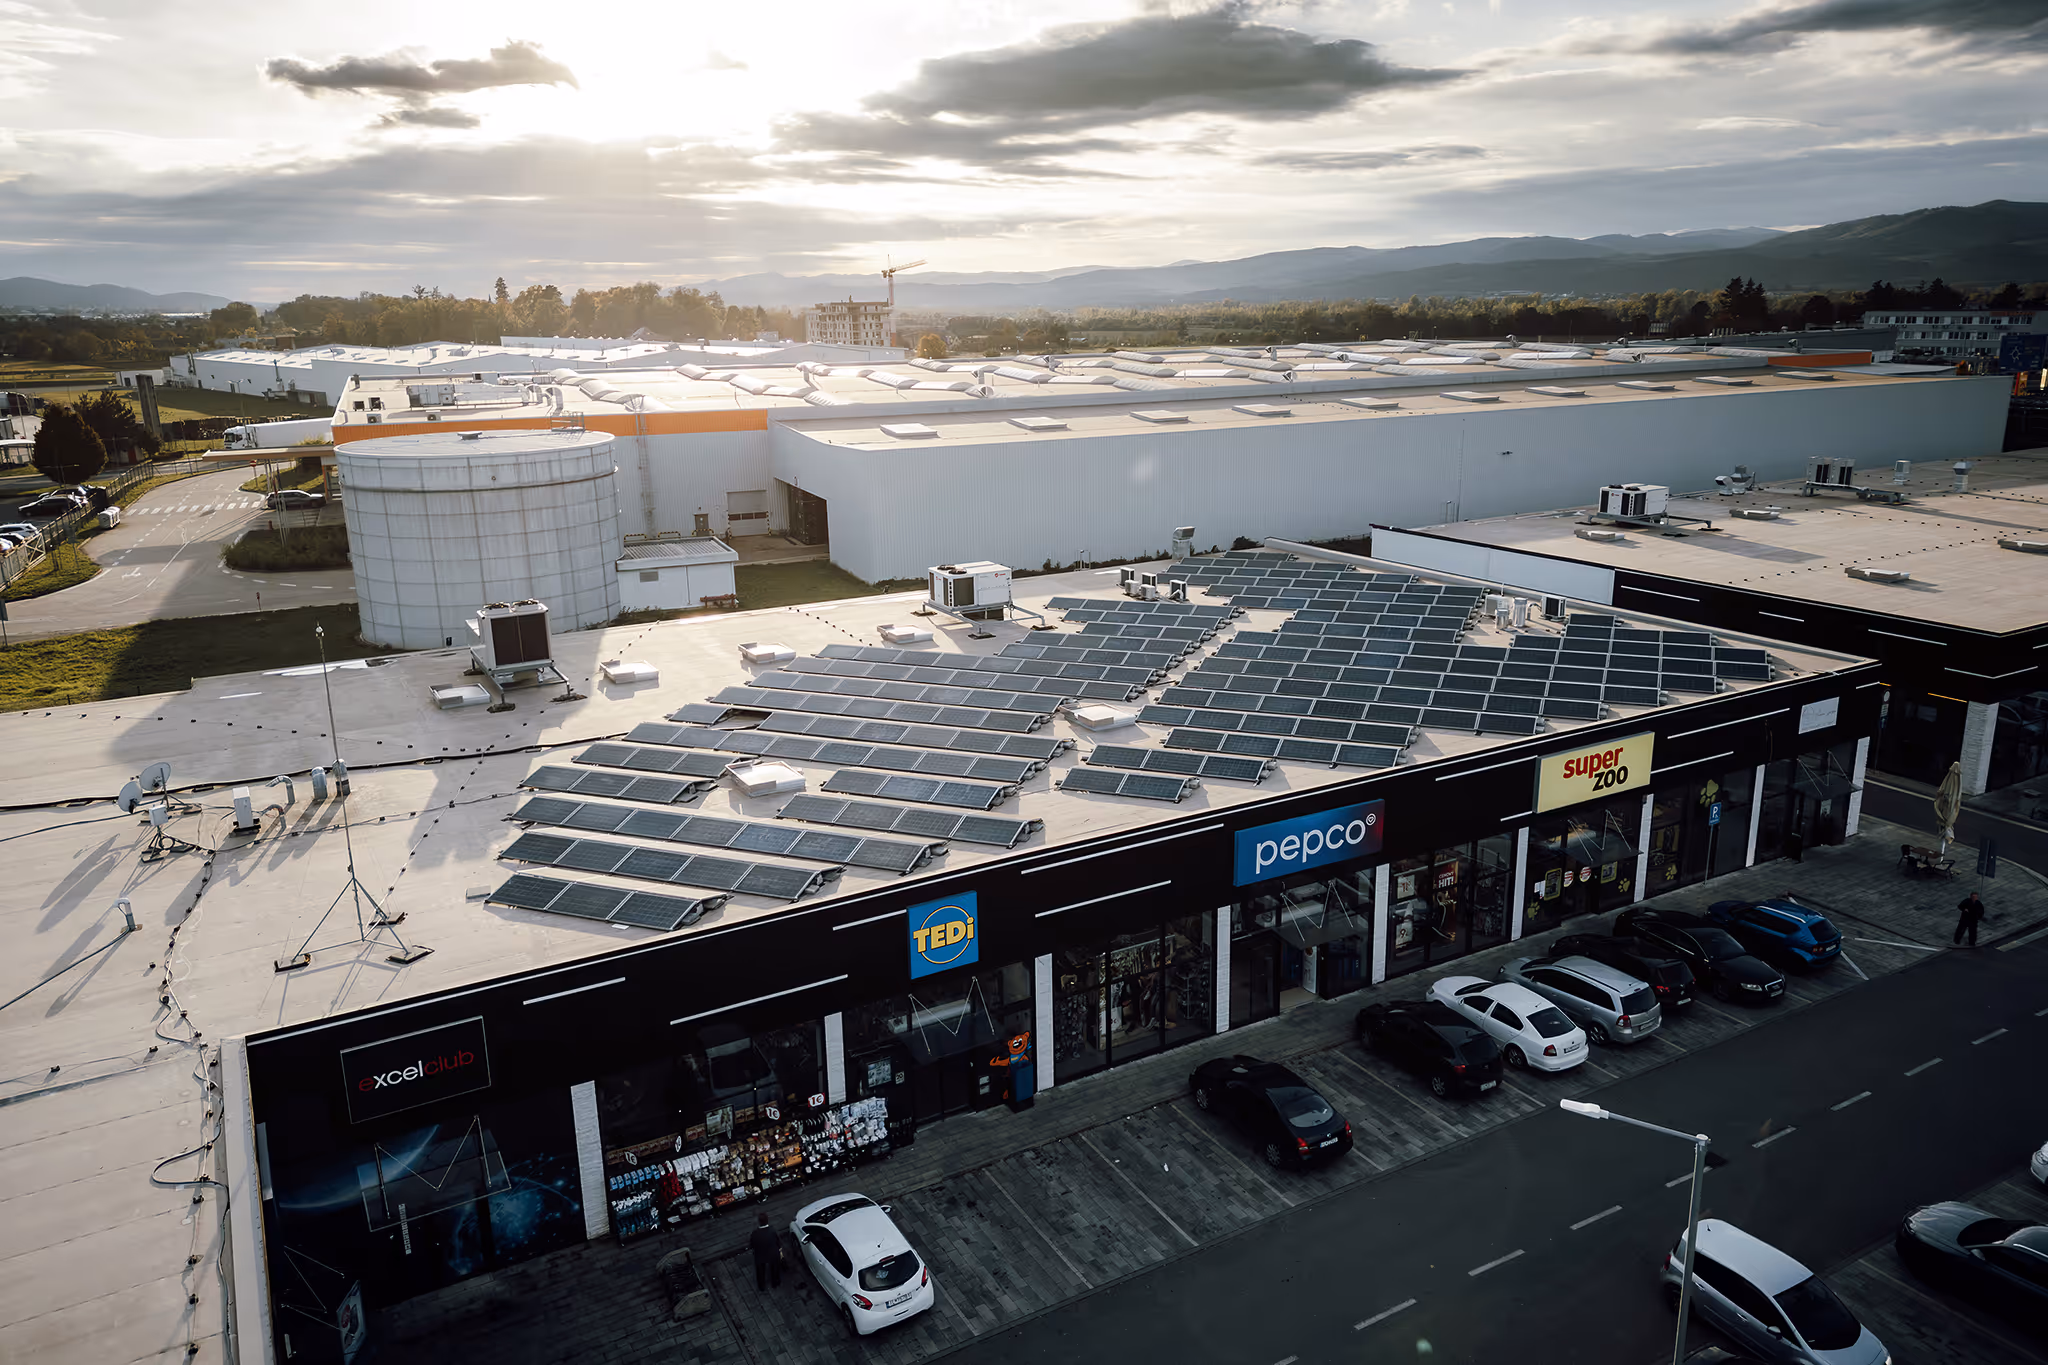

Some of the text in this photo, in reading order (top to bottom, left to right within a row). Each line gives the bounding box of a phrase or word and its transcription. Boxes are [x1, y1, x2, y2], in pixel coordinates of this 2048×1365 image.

[1563, 747, 1624, 779] super
[1592, 765, 1628, 791] zoo
[1712, 806, 1719, 818] P
[1255, 819, 1366, 874] pepco
[1438, 876, 1454, 888] HIT!
[913, 916, 975, 953] TEDi
[358, 1050, 475, 1092] excelclub
